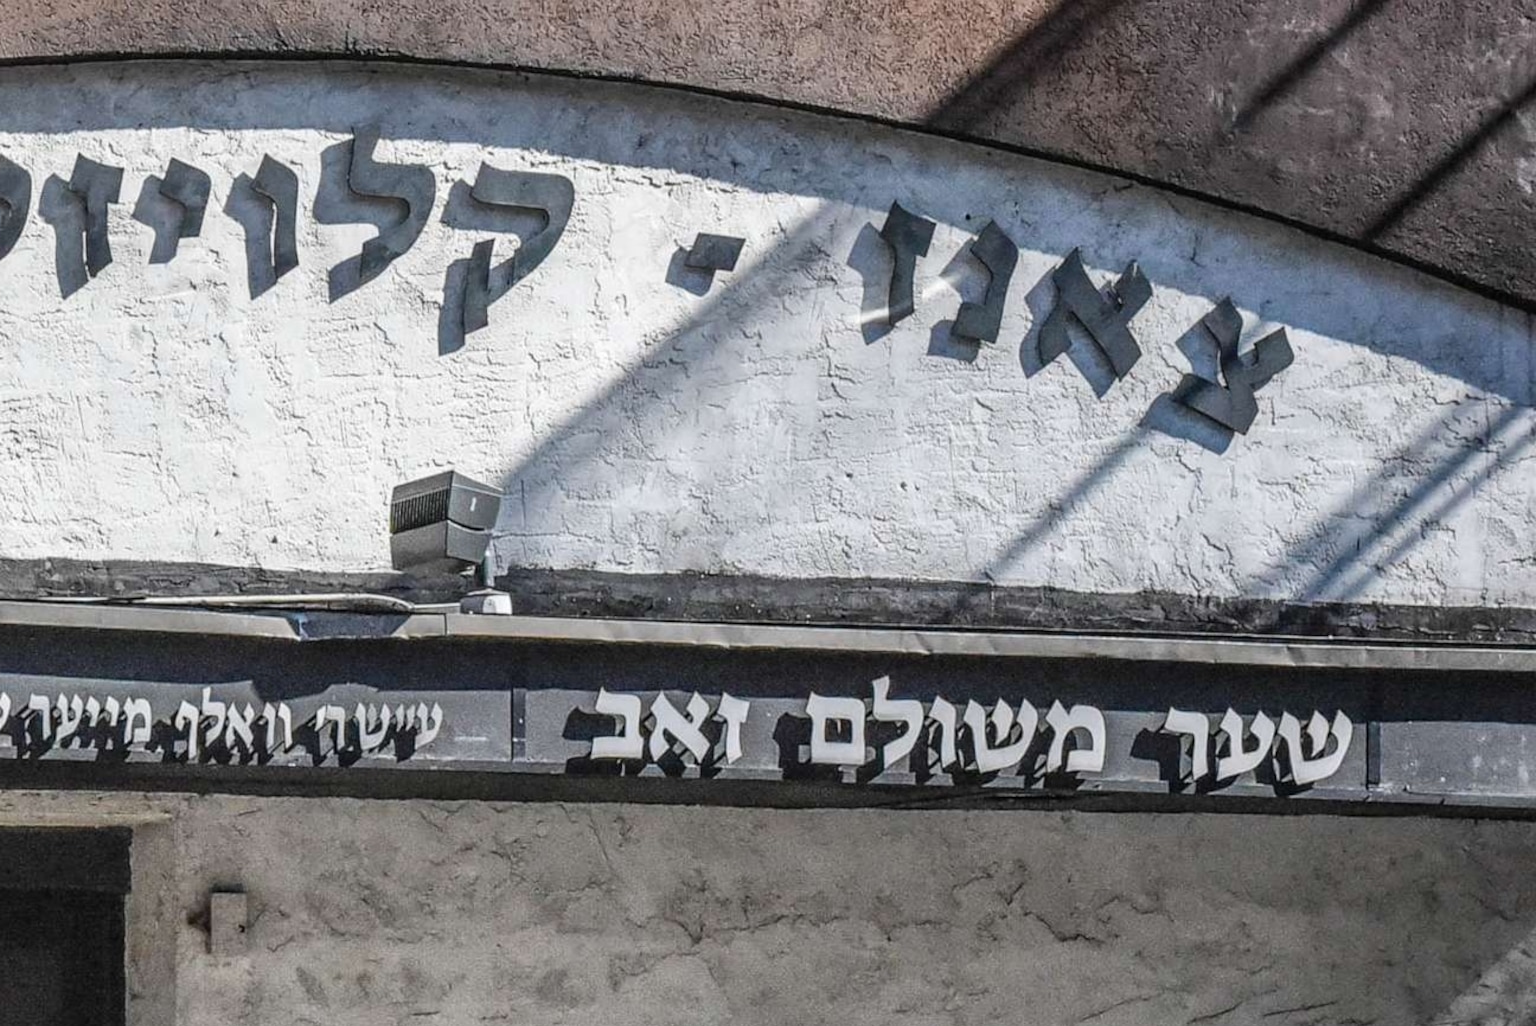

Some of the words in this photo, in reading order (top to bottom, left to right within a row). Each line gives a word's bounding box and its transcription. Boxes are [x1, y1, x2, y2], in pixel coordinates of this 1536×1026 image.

[880, 198, 1295, 434] צאנז
[28, 691, 152, 745] מייער
[174, 686, 293, 760] וואלף
[589, 685, 751, 765] זאב
[805, 674, 1107, 774] משולם
[1164, 705, 1354, 786] שער
